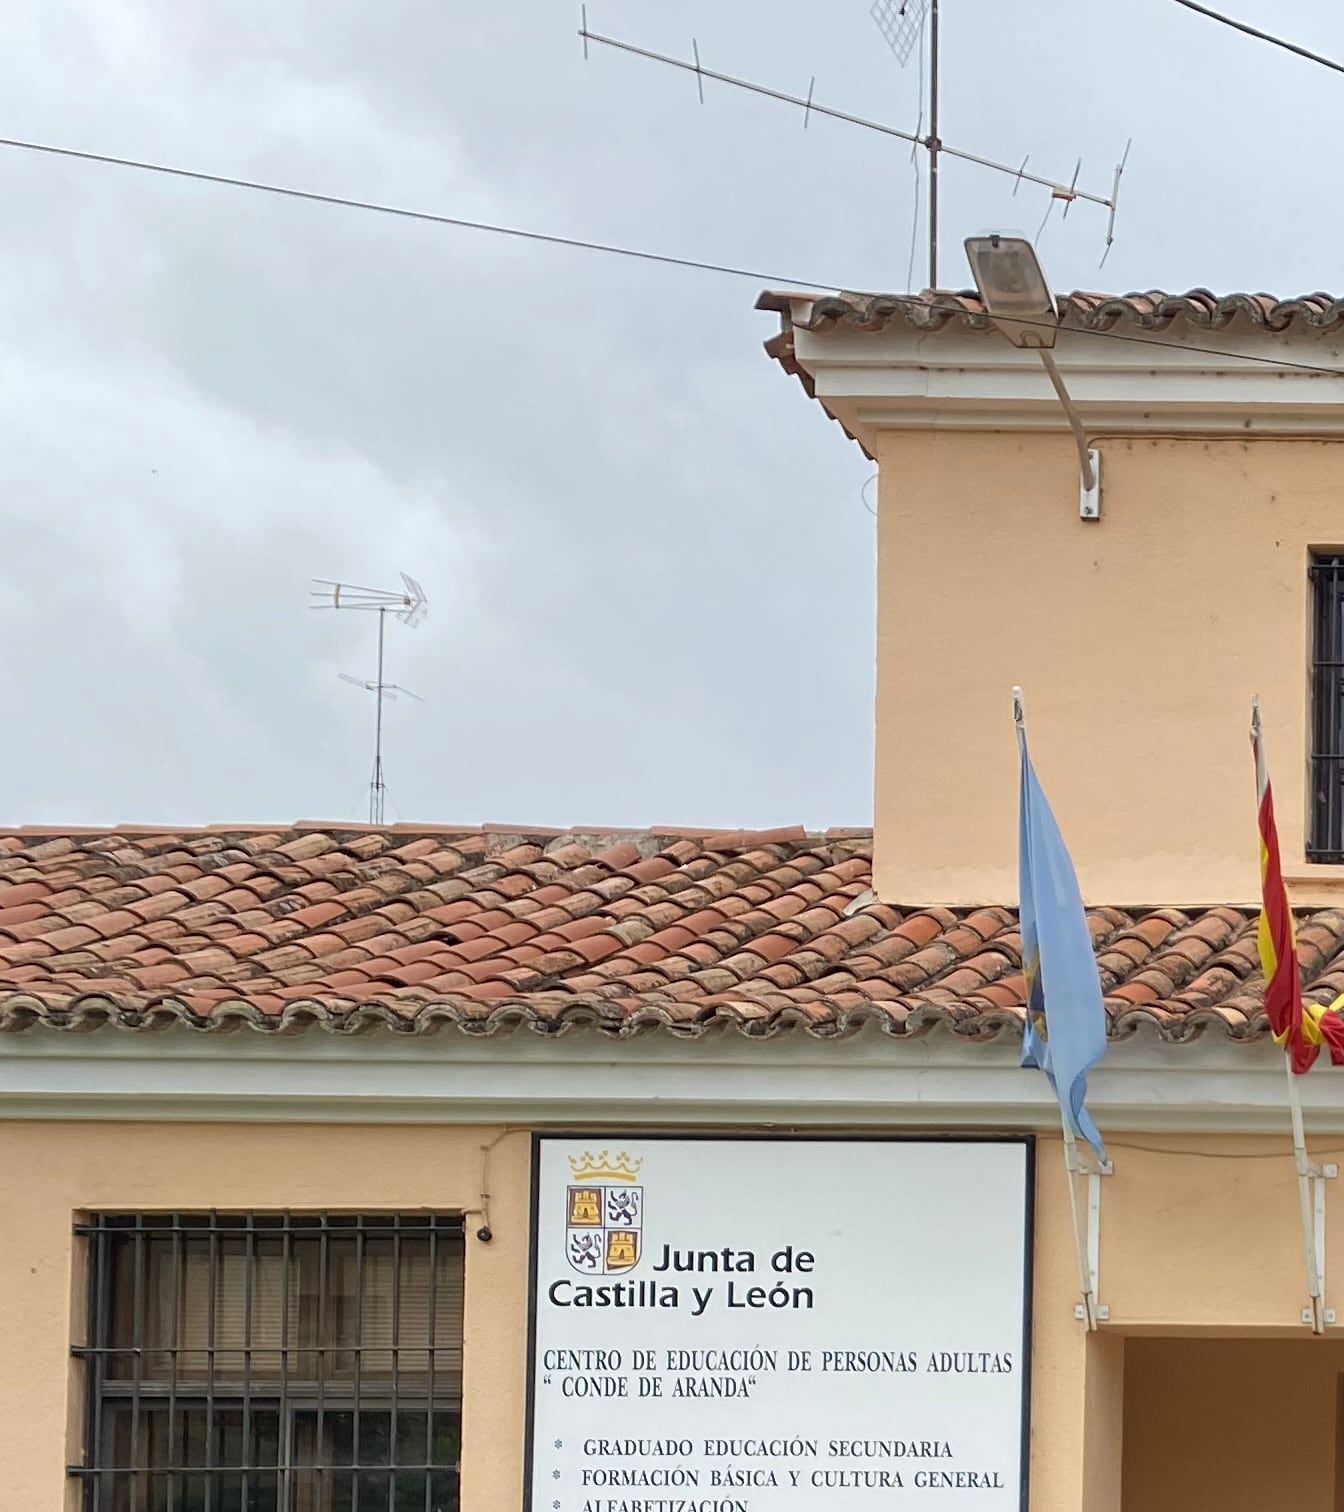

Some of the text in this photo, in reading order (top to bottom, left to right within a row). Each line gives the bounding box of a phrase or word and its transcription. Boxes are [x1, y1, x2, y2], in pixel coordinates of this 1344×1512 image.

[653, 1244, 814, 1273] Junta de
[549, 1280, 813, 1316] Castilla y León
[544, 1344, 1012, 1373] CENTRO DE EDUCACIÓN DE PERSONAS ADULTAS
[562, 1376, 628, 1397] CONDE
[639, 1377, 662, 1397] DE
[584, 1435, 953, 1457] GRADUADO EDUCACIÓN SECUNDARIA
[582, 1465, 1003, 1488] FORMACIÓN BÁSICA Y CULTURA GENERAL
